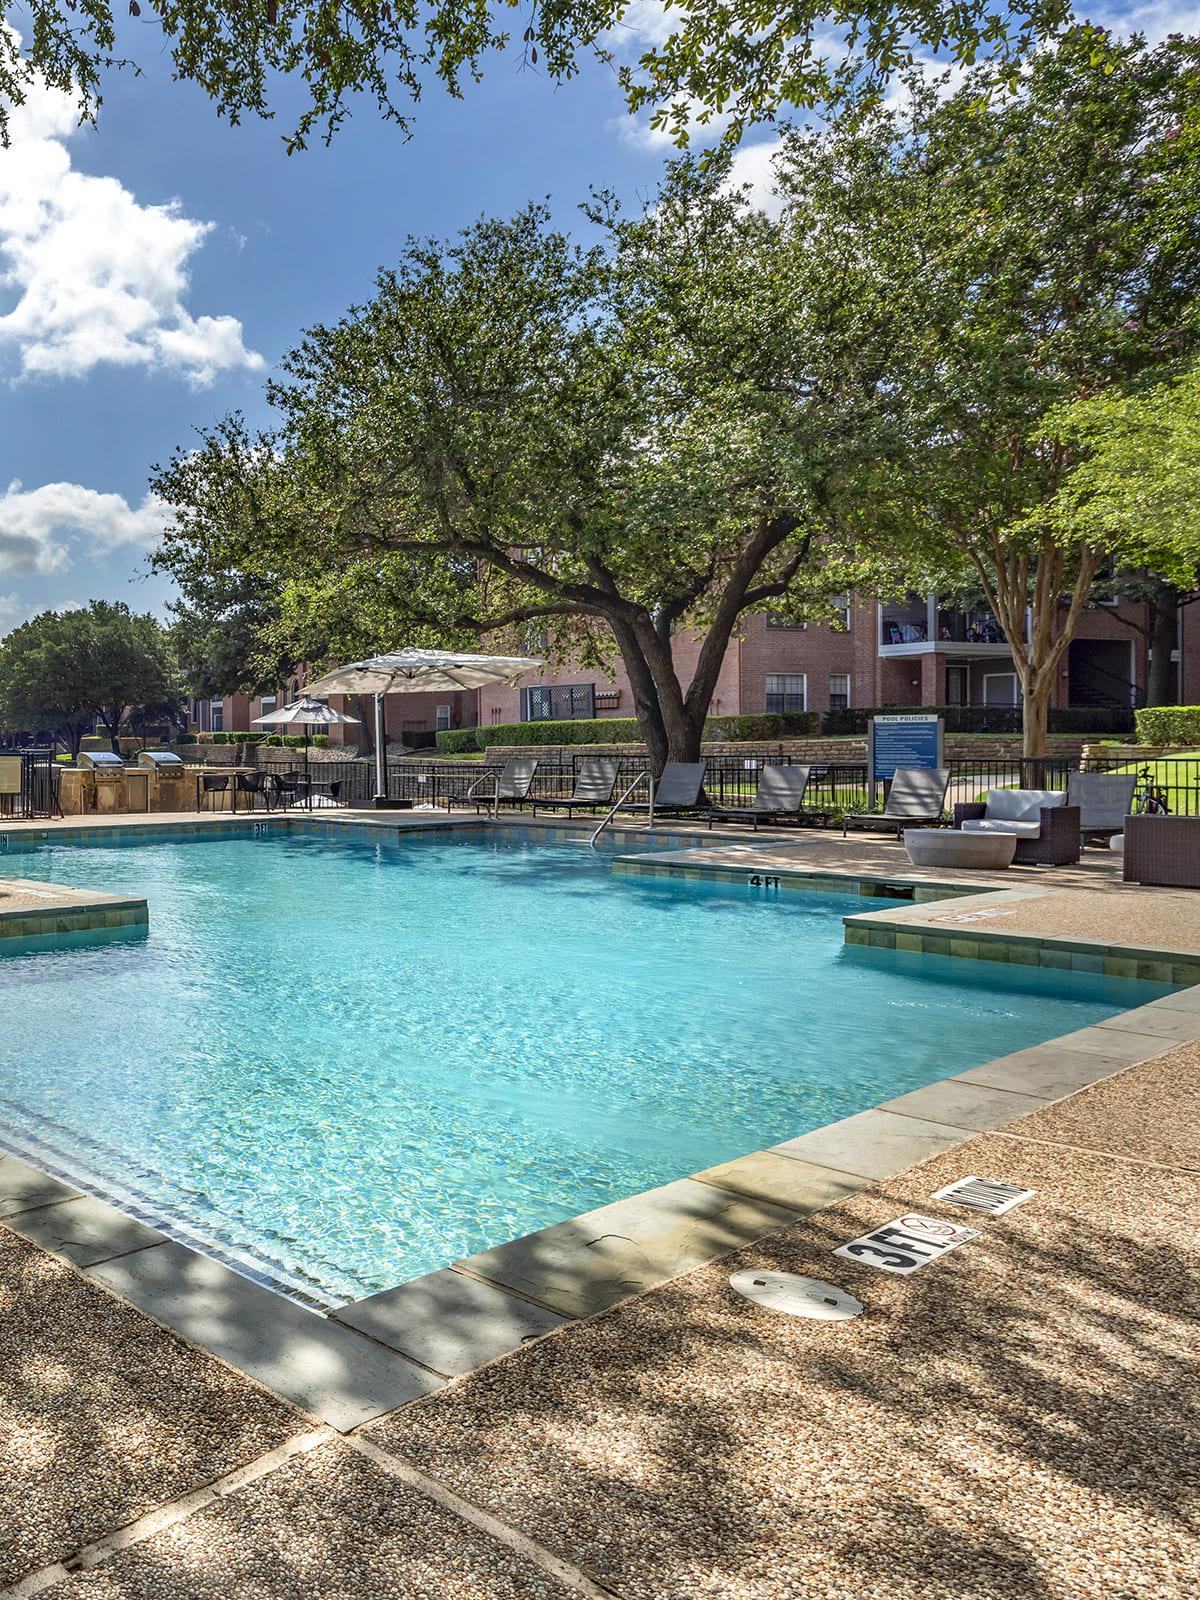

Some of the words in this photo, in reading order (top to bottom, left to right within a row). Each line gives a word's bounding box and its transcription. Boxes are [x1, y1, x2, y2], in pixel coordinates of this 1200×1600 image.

[750, 875, 761, 887] 4
[765, 876, 780, 888] FT
[847, 1244, 917, 1268] 3
